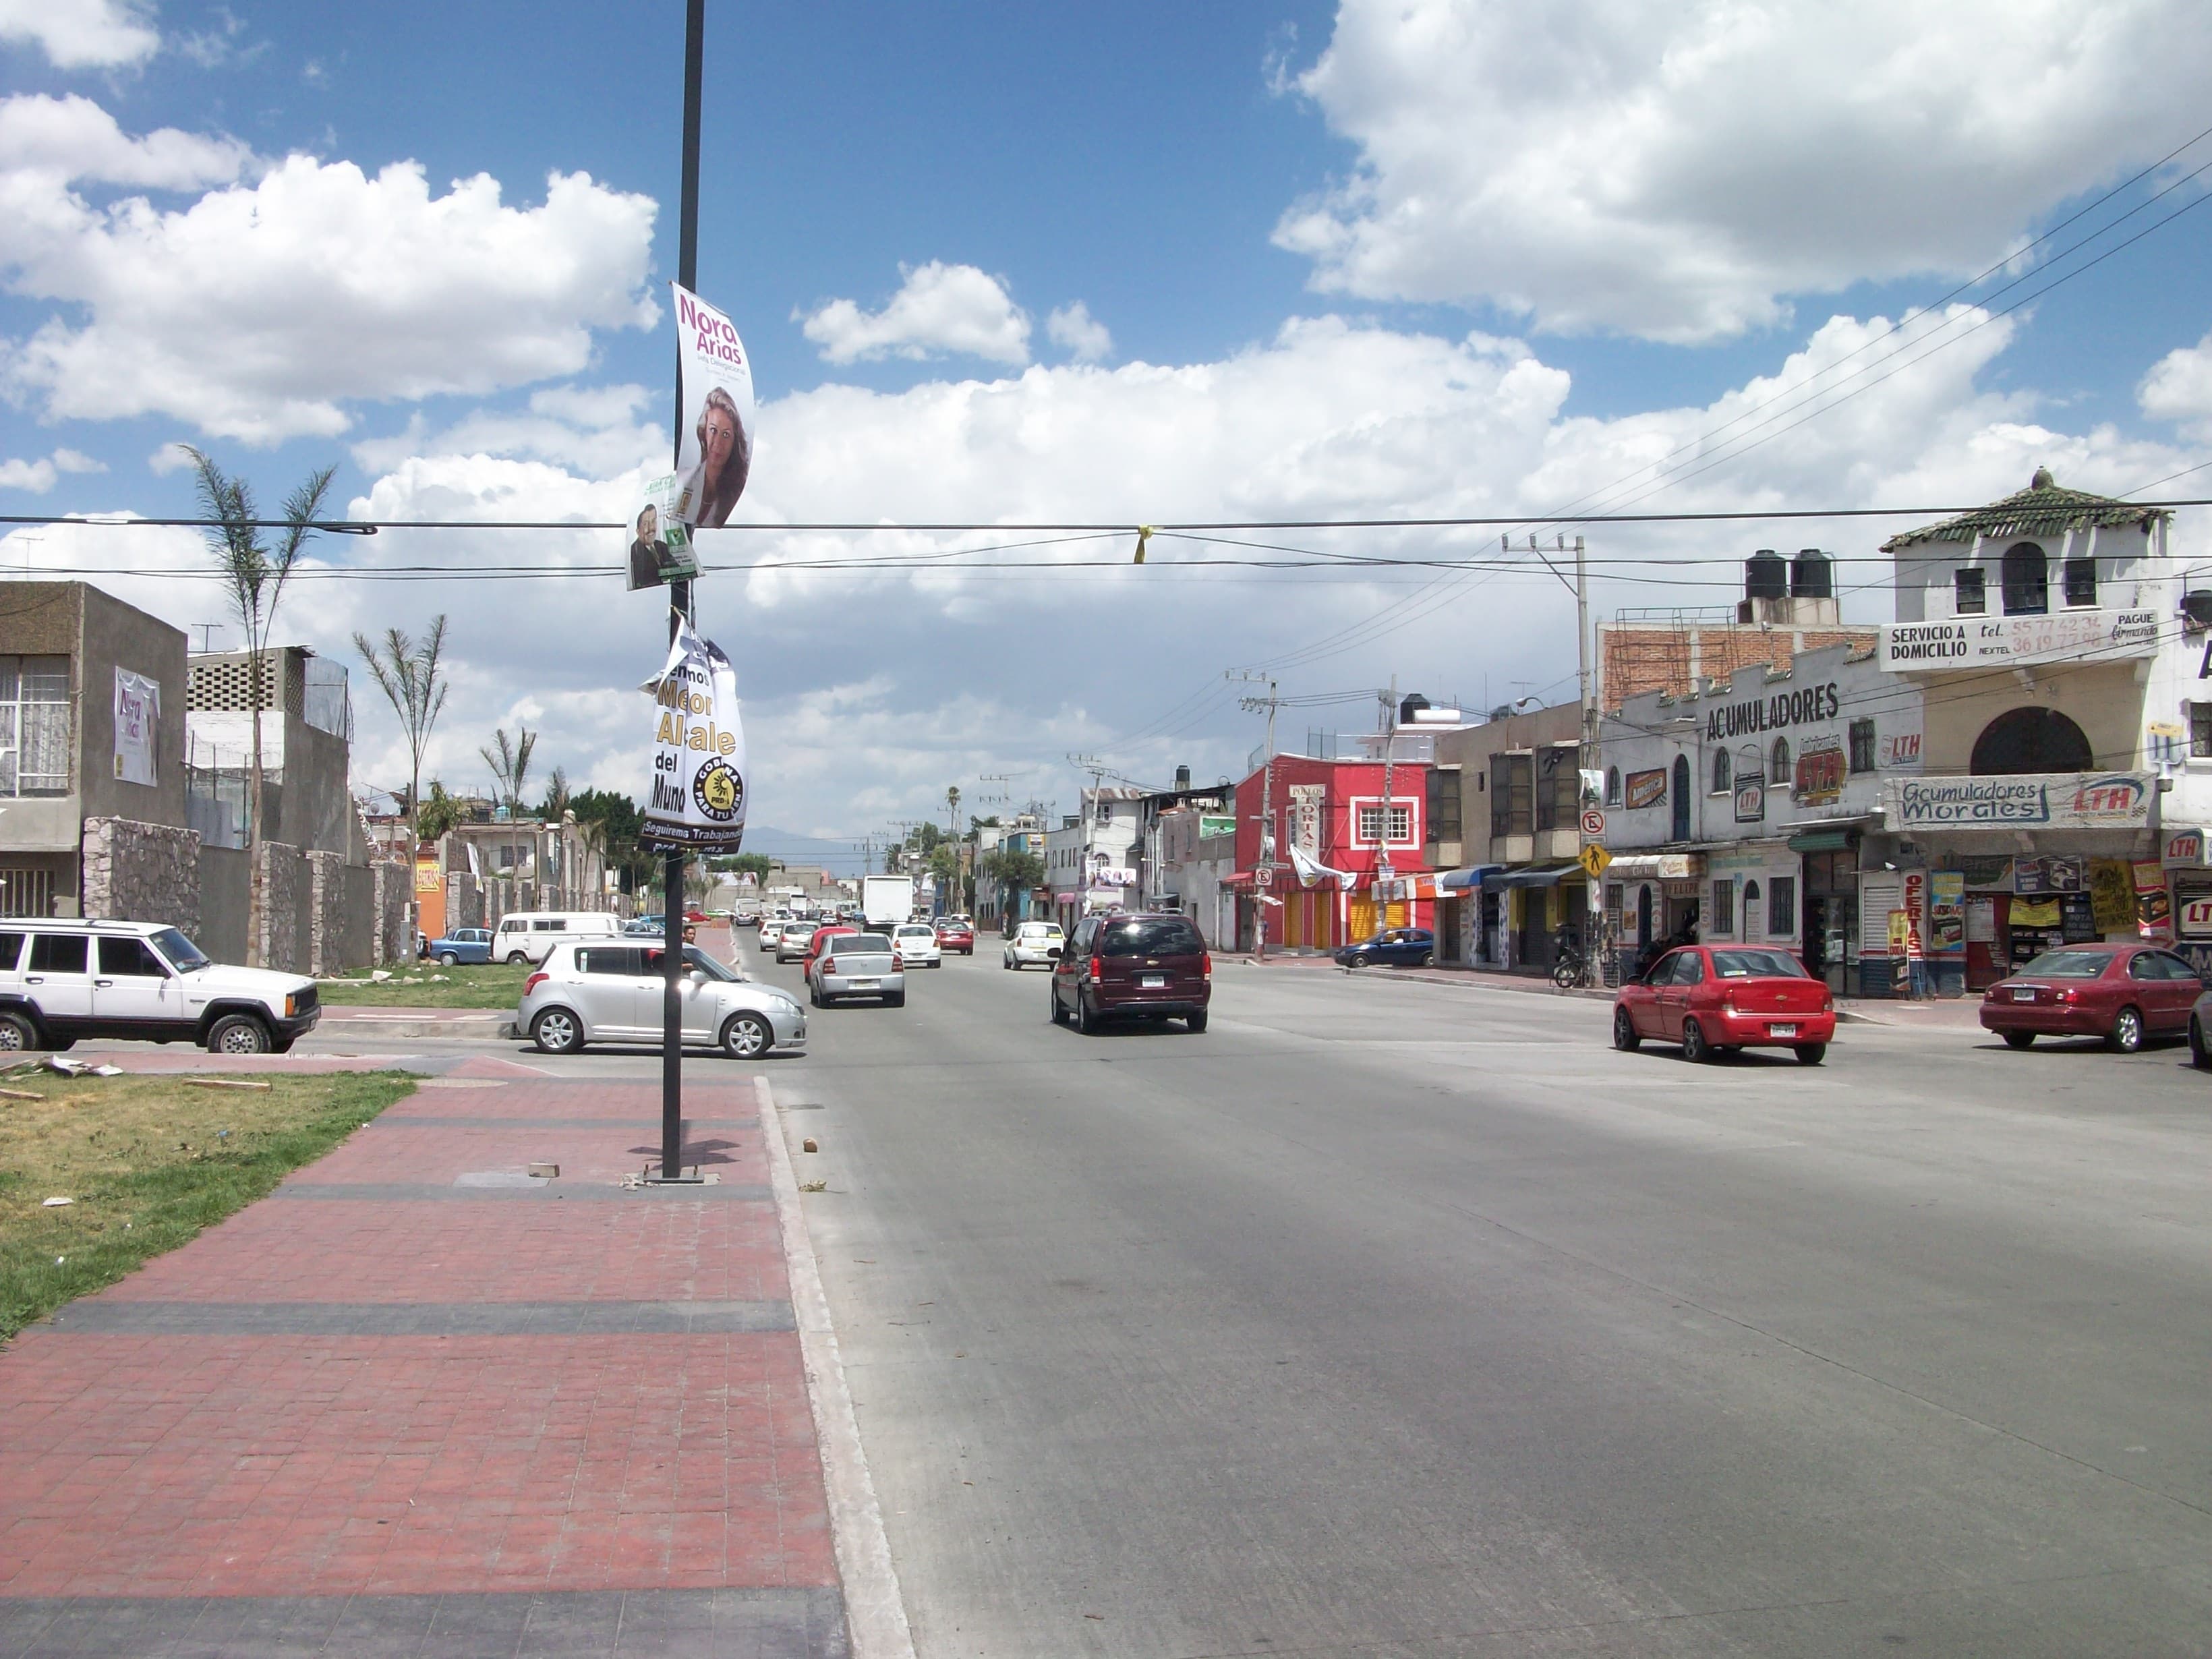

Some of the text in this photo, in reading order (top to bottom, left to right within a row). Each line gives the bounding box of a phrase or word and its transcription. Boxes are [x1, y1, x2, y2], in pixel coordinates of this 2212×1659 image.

[680, 293, 738, 346] Nora
[697, 332, 742, 365] Arias
[1981, 623, 2004, 637] tel.
[2118, 613, 2154, 624] PAGUE
[1892, 624, 1965, 643] SERVICIO A
[1891, 641, 1967, 660] DOMICILIO
[1979, 646, 2010, 655] NEXTEL
[658, 679, 713, 716] Meor
[1706, 682, 1838, 742] ACUMULADORES
[656, 711, 736, 755] Alale
[1892, 734, 1921, 758] LTH
[656, 751, 678, 773] del
[1292, 788, 1323, 796] POLLOS
[1739, 790, 1759, 810] LTH
[2073, 787, 2131, 811] LTH
[695, 791, 715, 817] PARA
[716, 811, 729, 819] TU
[1302, 797, 1315, 849] TORTAS
[2167, 838, 2198, 858] LTH
[1905, 875, 1923, 953] OFERTAS
[2188, 903, 2212, 923] LT
